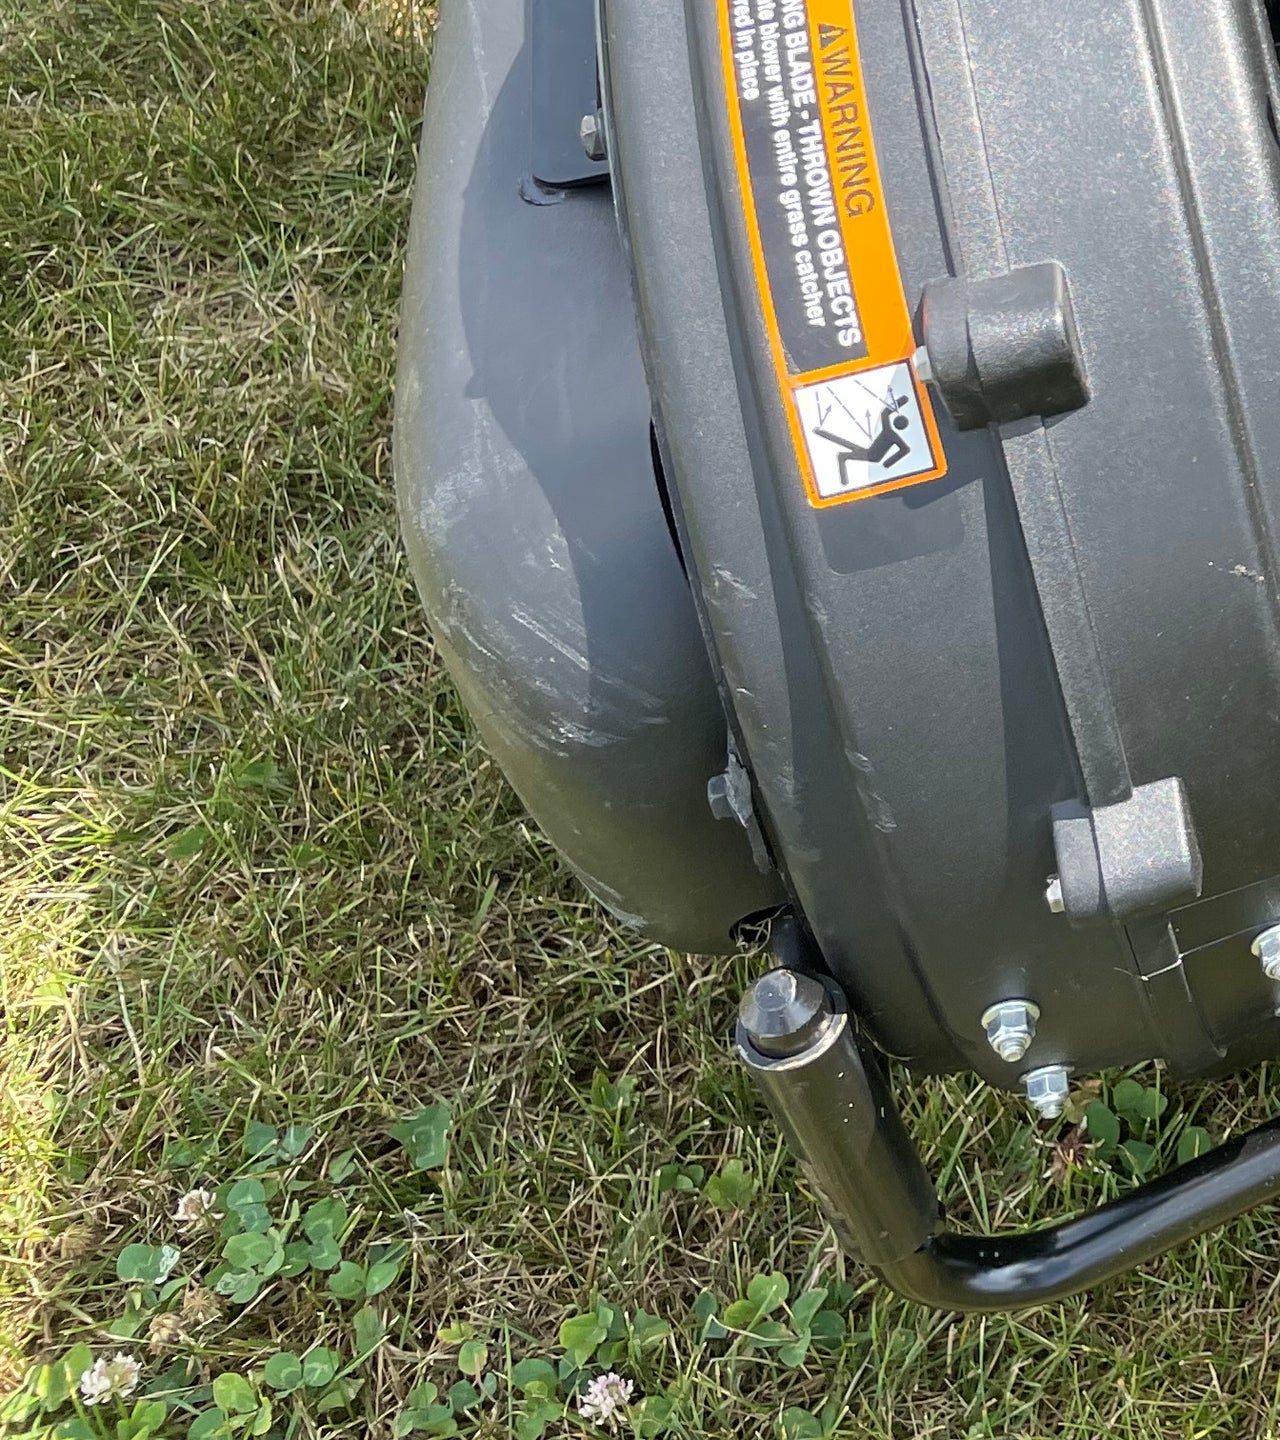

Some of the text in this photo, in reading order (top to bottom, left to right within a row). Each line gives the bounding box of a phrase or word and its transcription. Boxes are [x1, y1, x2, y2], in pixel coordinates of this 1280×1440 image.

[736, 28, 756, 49] in
[758, 22, 781, 83] blower
[735, 51, 760, 101] place
[785, 30, 817, 109] BLADE
[766, 83, 792, 127] with
[819, 43, 875, 219] WARNING
[773, 128, 798, 186] entire
[796, 119, 836, 227] THROWN
[779, 189, 808, 247] grass
[795, 250, 826, 327] catcher
[817, 229, 861, 347] OBJECTS
